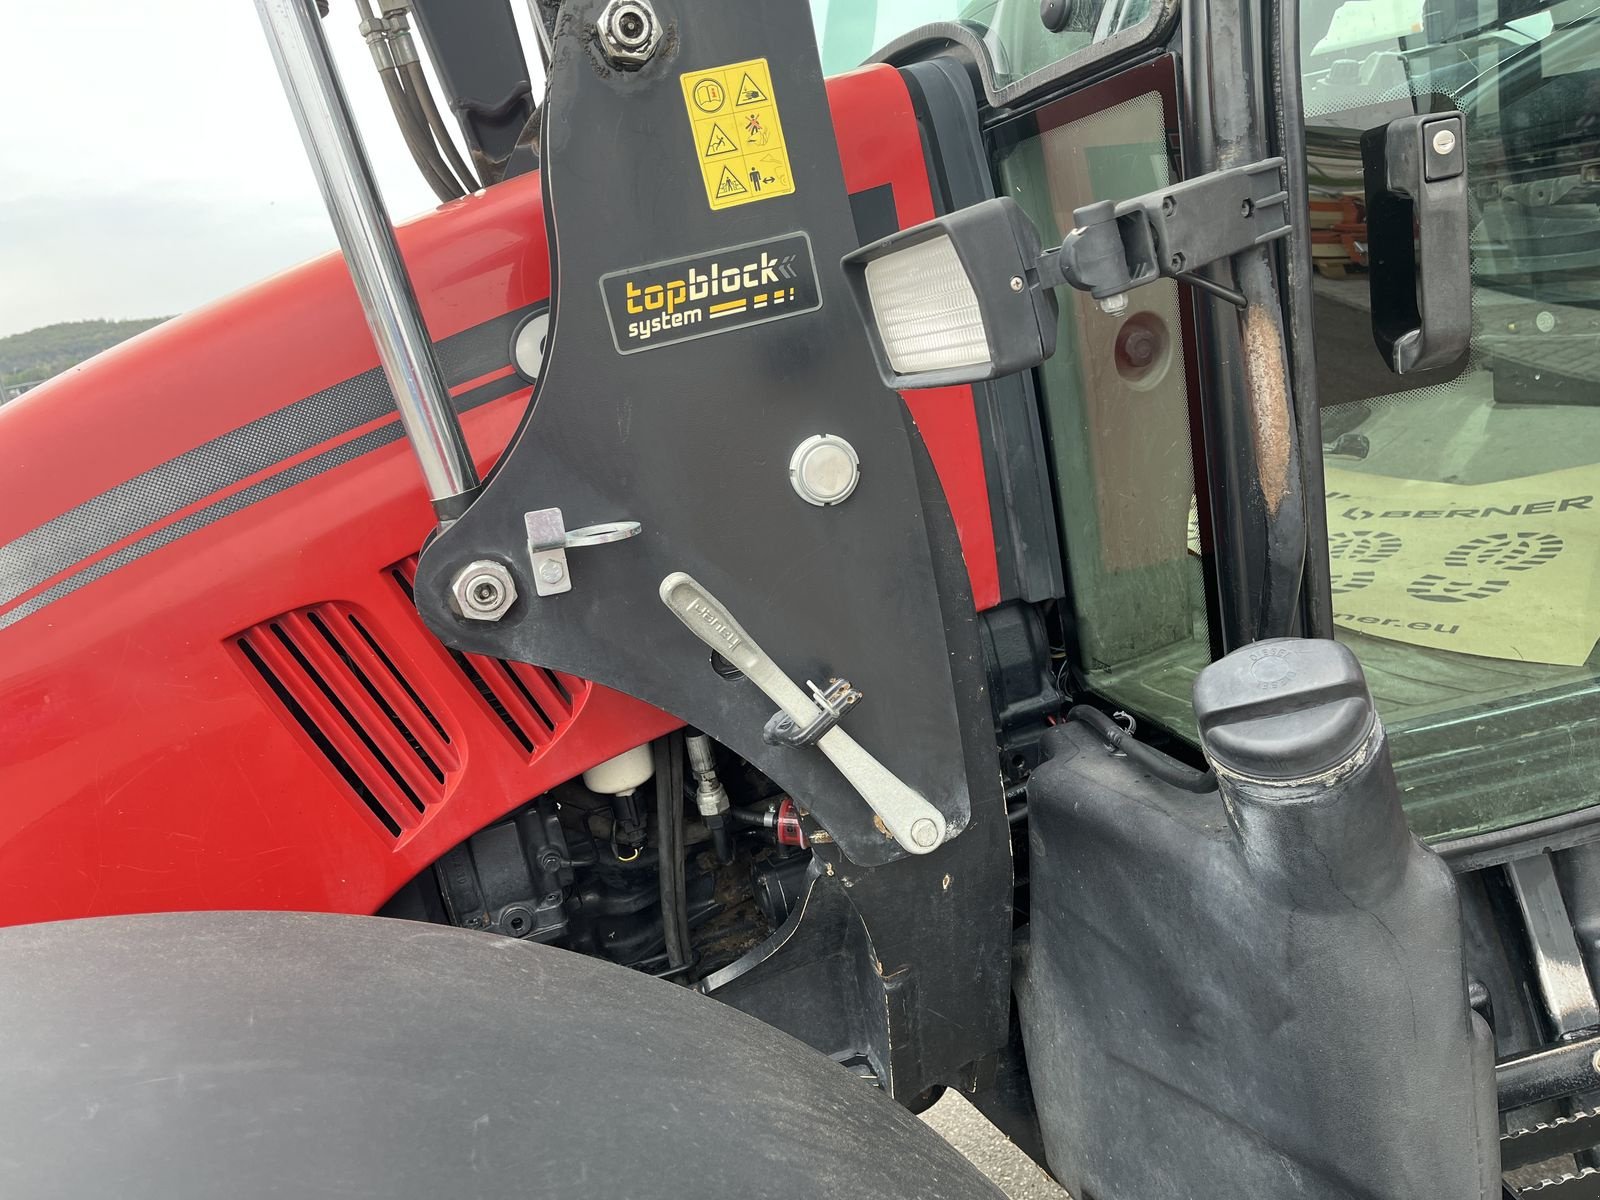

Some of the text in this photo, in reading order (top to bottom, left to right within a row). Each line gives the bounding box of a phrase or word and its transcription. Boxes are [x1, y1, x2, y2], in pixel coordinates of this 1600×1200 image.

[626, 252, 779, 314] topblock
[628, 308, 702, 339] system
[1378, 495, 1594, 519] BERNER
[1249, 648, 1290, 661] DIESEL
